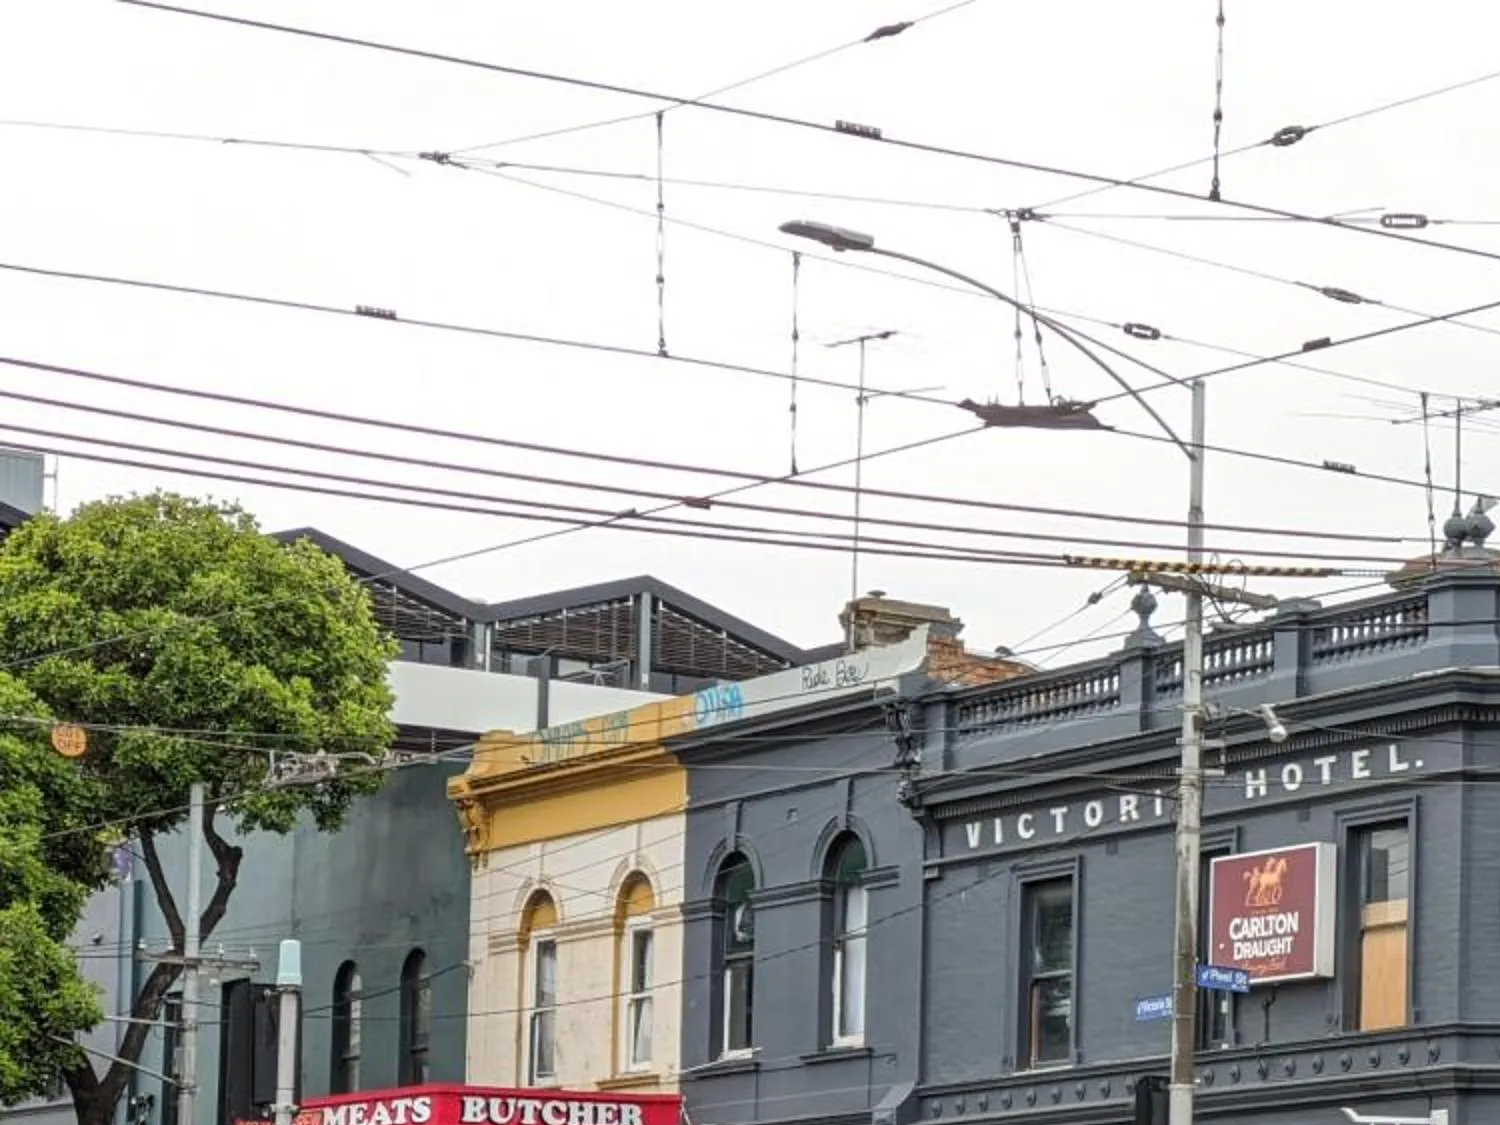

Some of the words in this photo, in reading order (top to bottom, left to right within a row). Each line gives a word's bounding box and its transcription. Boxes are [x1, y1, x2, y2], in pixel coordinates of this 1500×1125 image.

[965, 788, 1166, 849] VICTORI
[1245, 744, 1424, 799] HOTEL.
[1229, 911, 1299, 941] CARLTON
[1233, 935, 1294, 961] DRAUGHT
